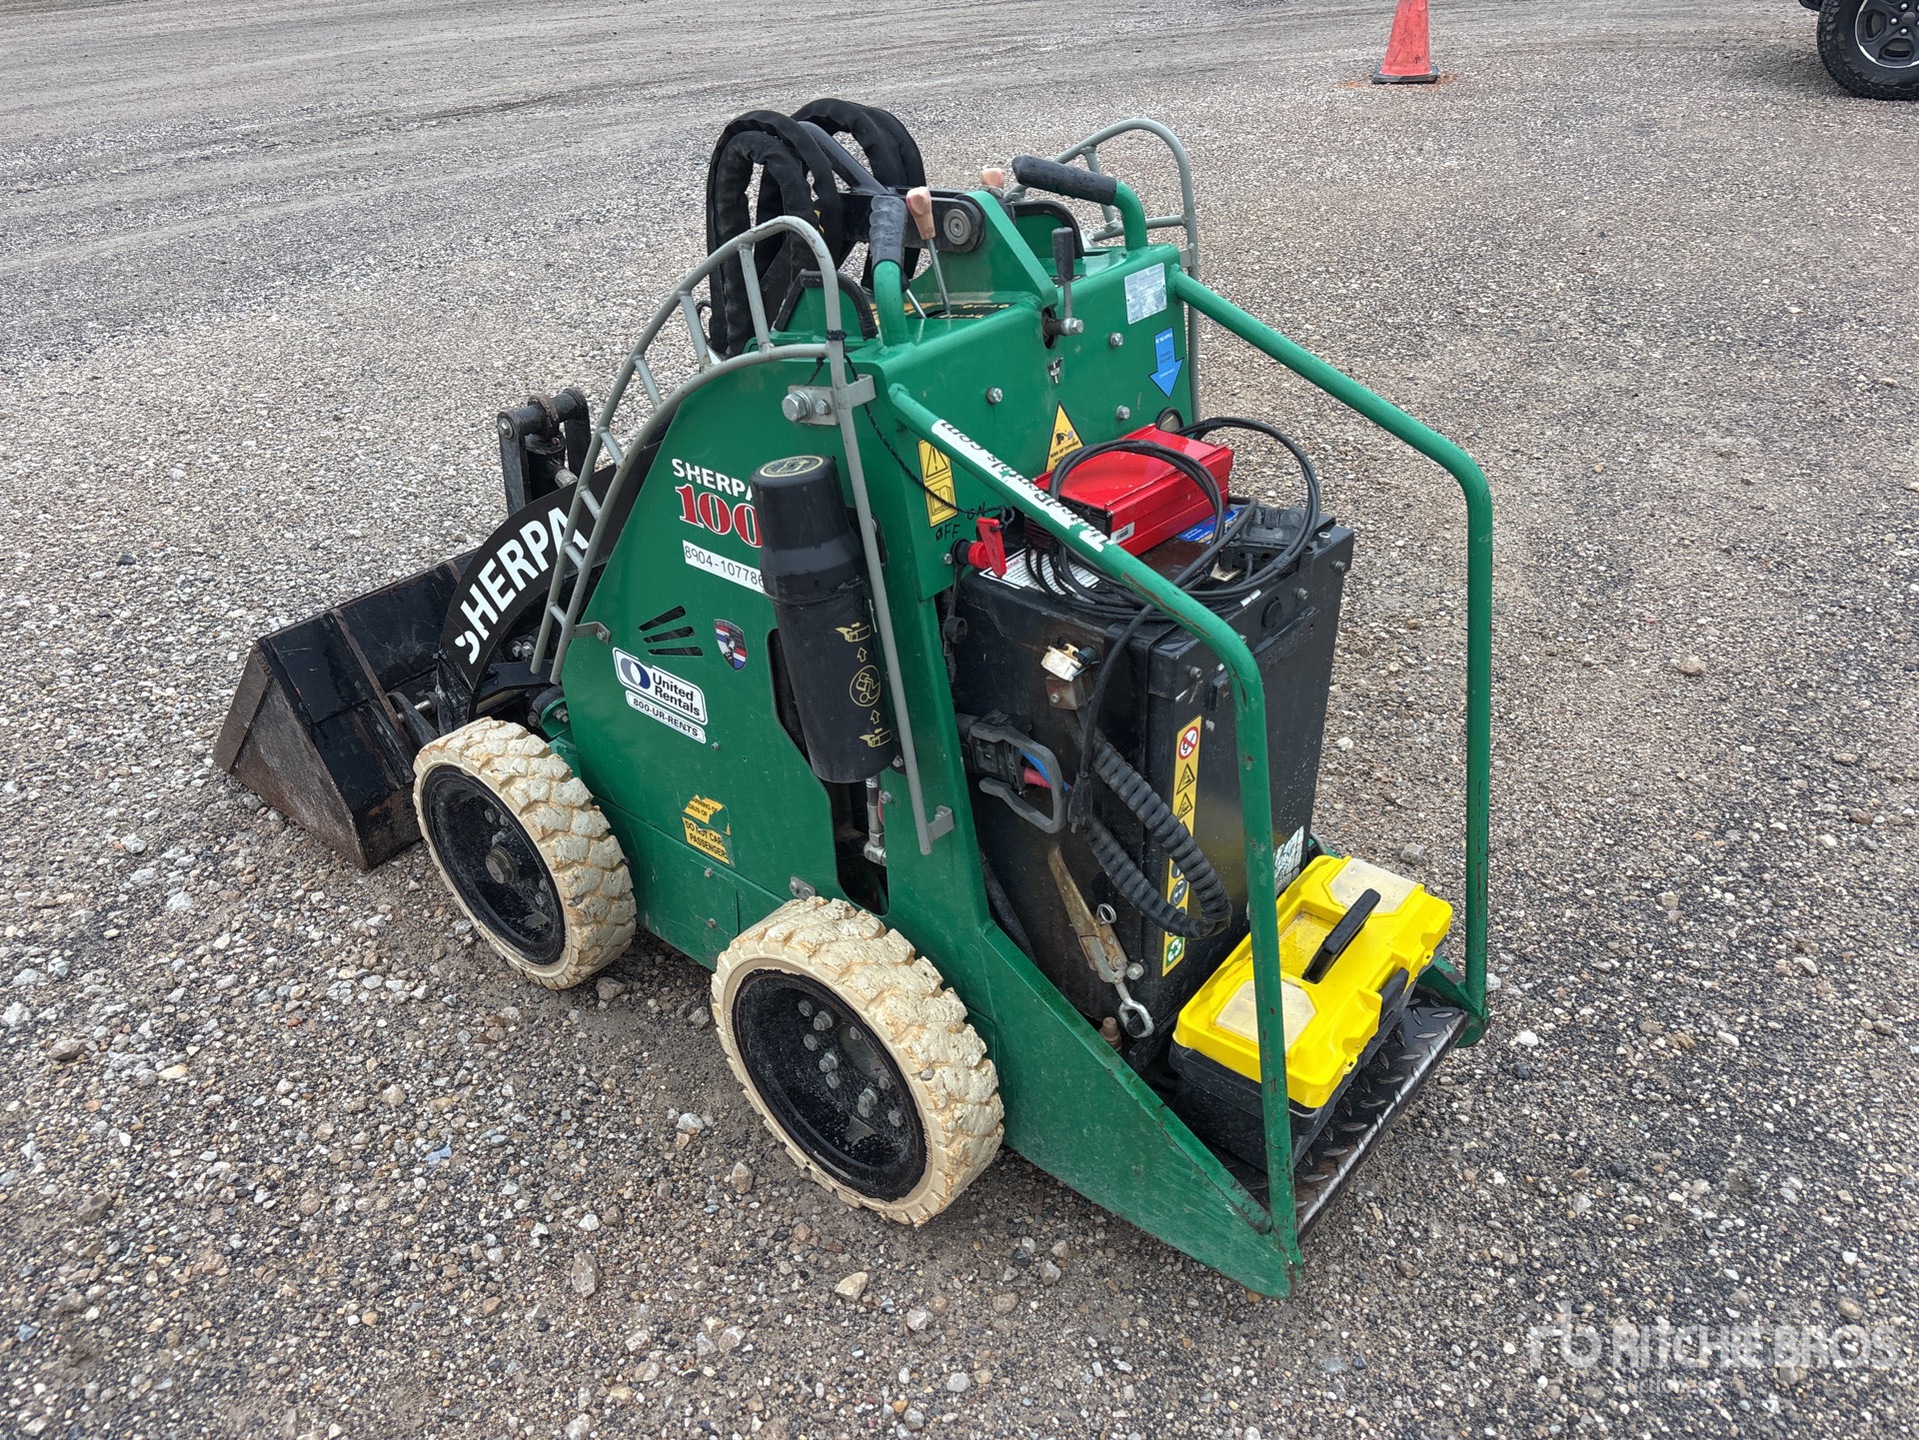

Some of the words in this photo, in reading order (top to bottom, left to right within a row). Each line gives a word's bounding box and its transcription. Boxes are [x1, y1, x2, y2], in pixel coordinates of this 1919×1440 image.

[935, 522, 961, 541] OFF
[652, 672, 694, 702] United
[654, 685, 700, 717] Rentals
[633, 697, 698, 737] 800-UR-RENTS
[684, 820, 695, 832] DO
[709, 832, 725, 846] CAR
[689, 833, 727, 857] PASSENGER
